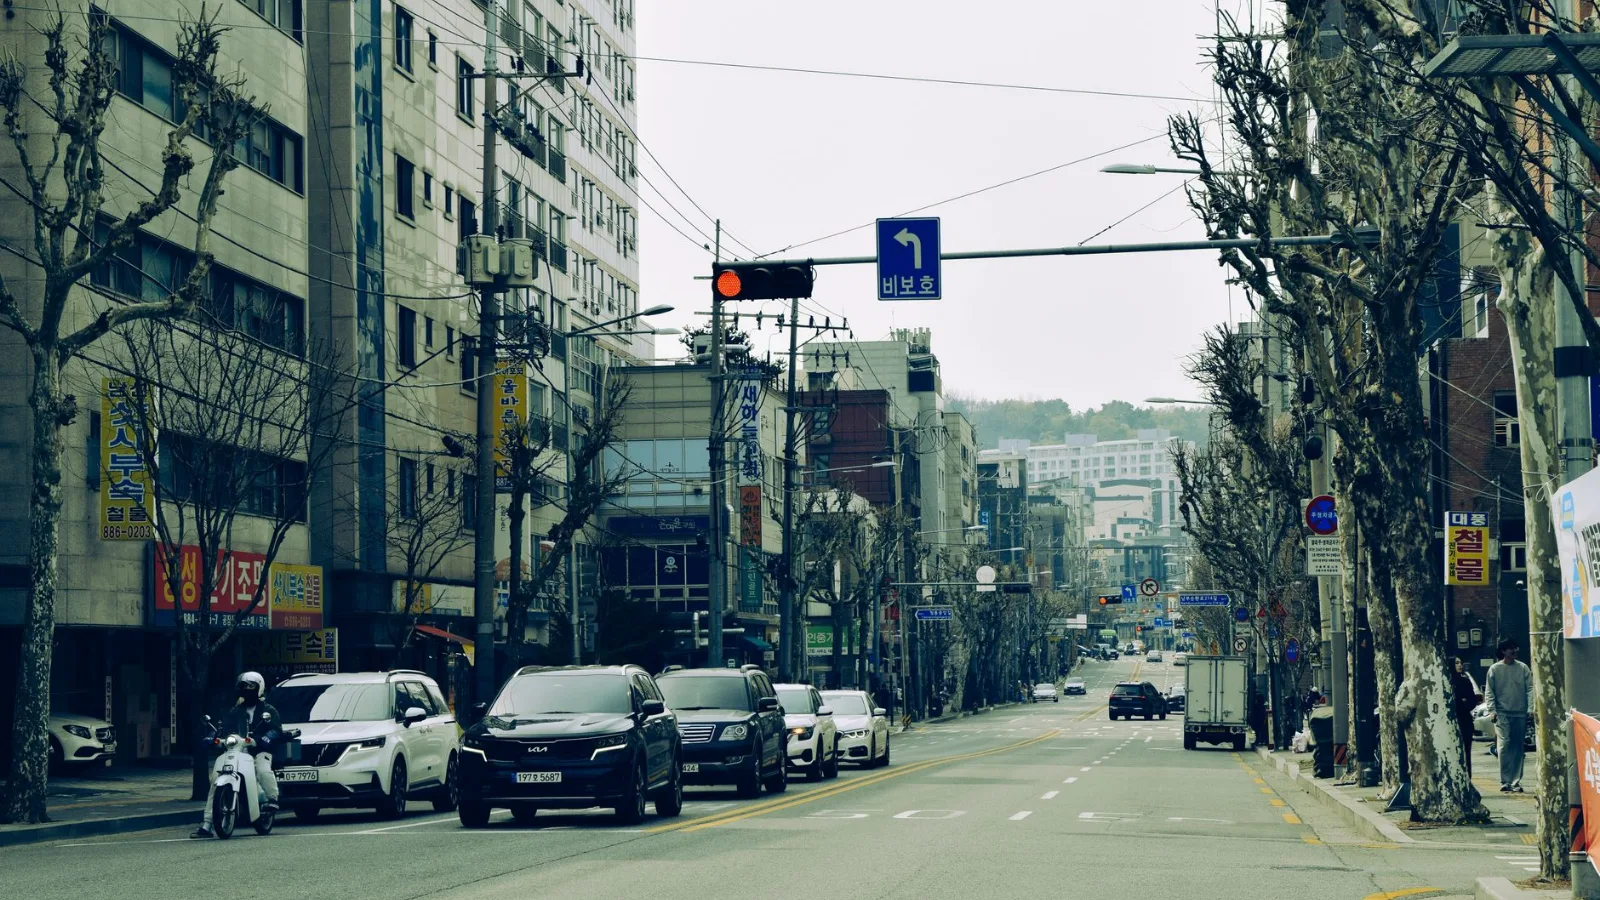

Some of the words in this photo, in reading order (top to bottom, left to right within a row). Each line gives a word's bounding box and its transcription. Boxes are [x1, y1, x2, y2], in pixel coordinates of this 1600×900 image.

[883, 275, 936, 296] 비보호
[107, 506, 147, 522] 철물
[1452, 513, 1486, 526] 대풍
[103, 525, 150, 539] 886-0203
[1454, 529, 1483, 582] 철물
[305, 573, 320, 607] 철물
[297, 772, 316, 780] 7976
[540, 773, 560, 782] 5687
